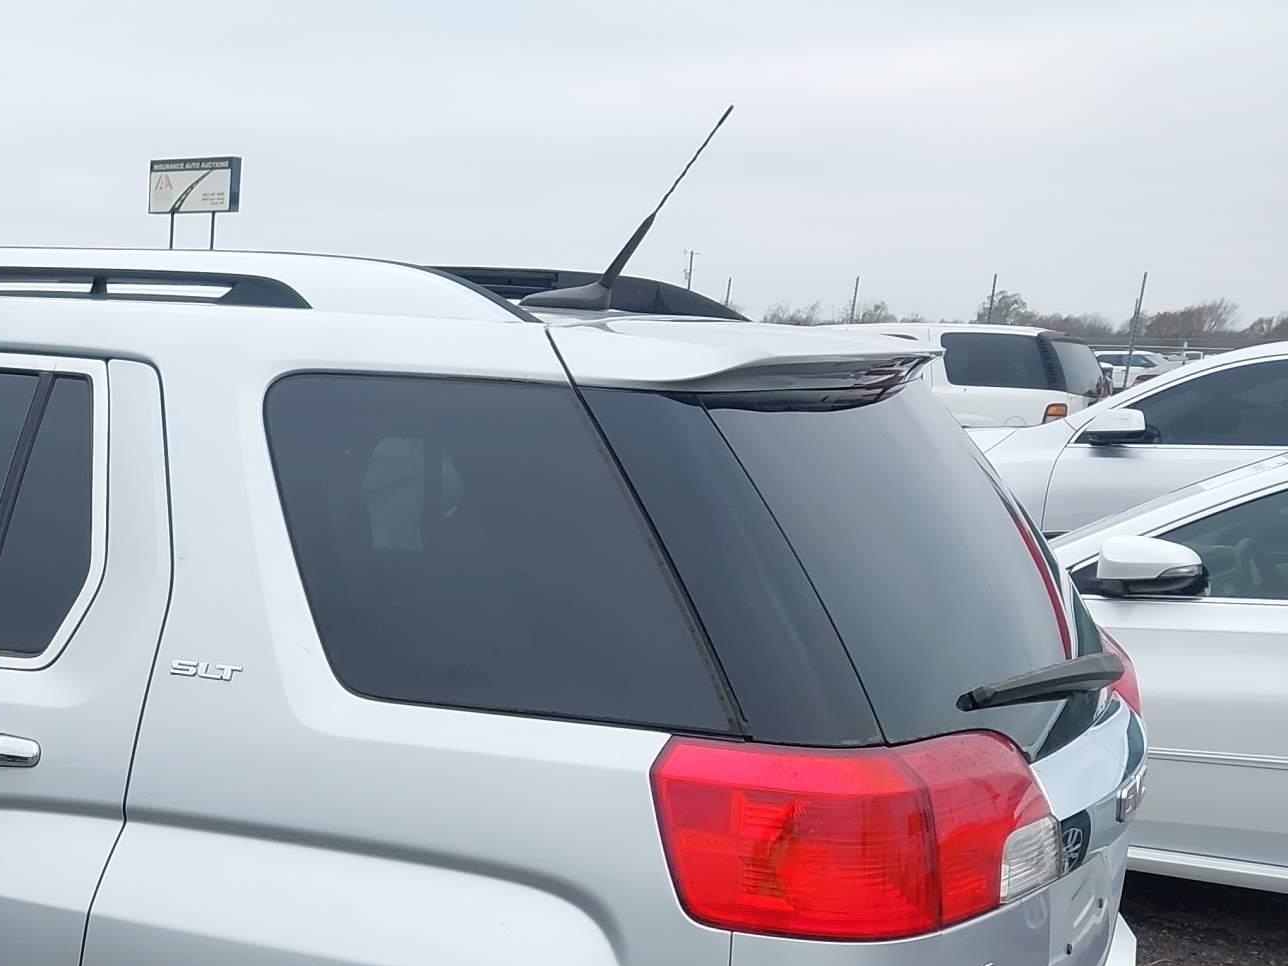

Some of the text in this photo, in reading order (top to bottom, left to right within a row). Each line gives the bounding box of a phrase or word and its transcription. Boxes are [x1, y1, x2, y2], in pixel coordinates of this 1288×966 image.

[153, 160, 229, 171] INSURANCE AUTO AUCTIONS
[170, 659, 244, 682] SLT
